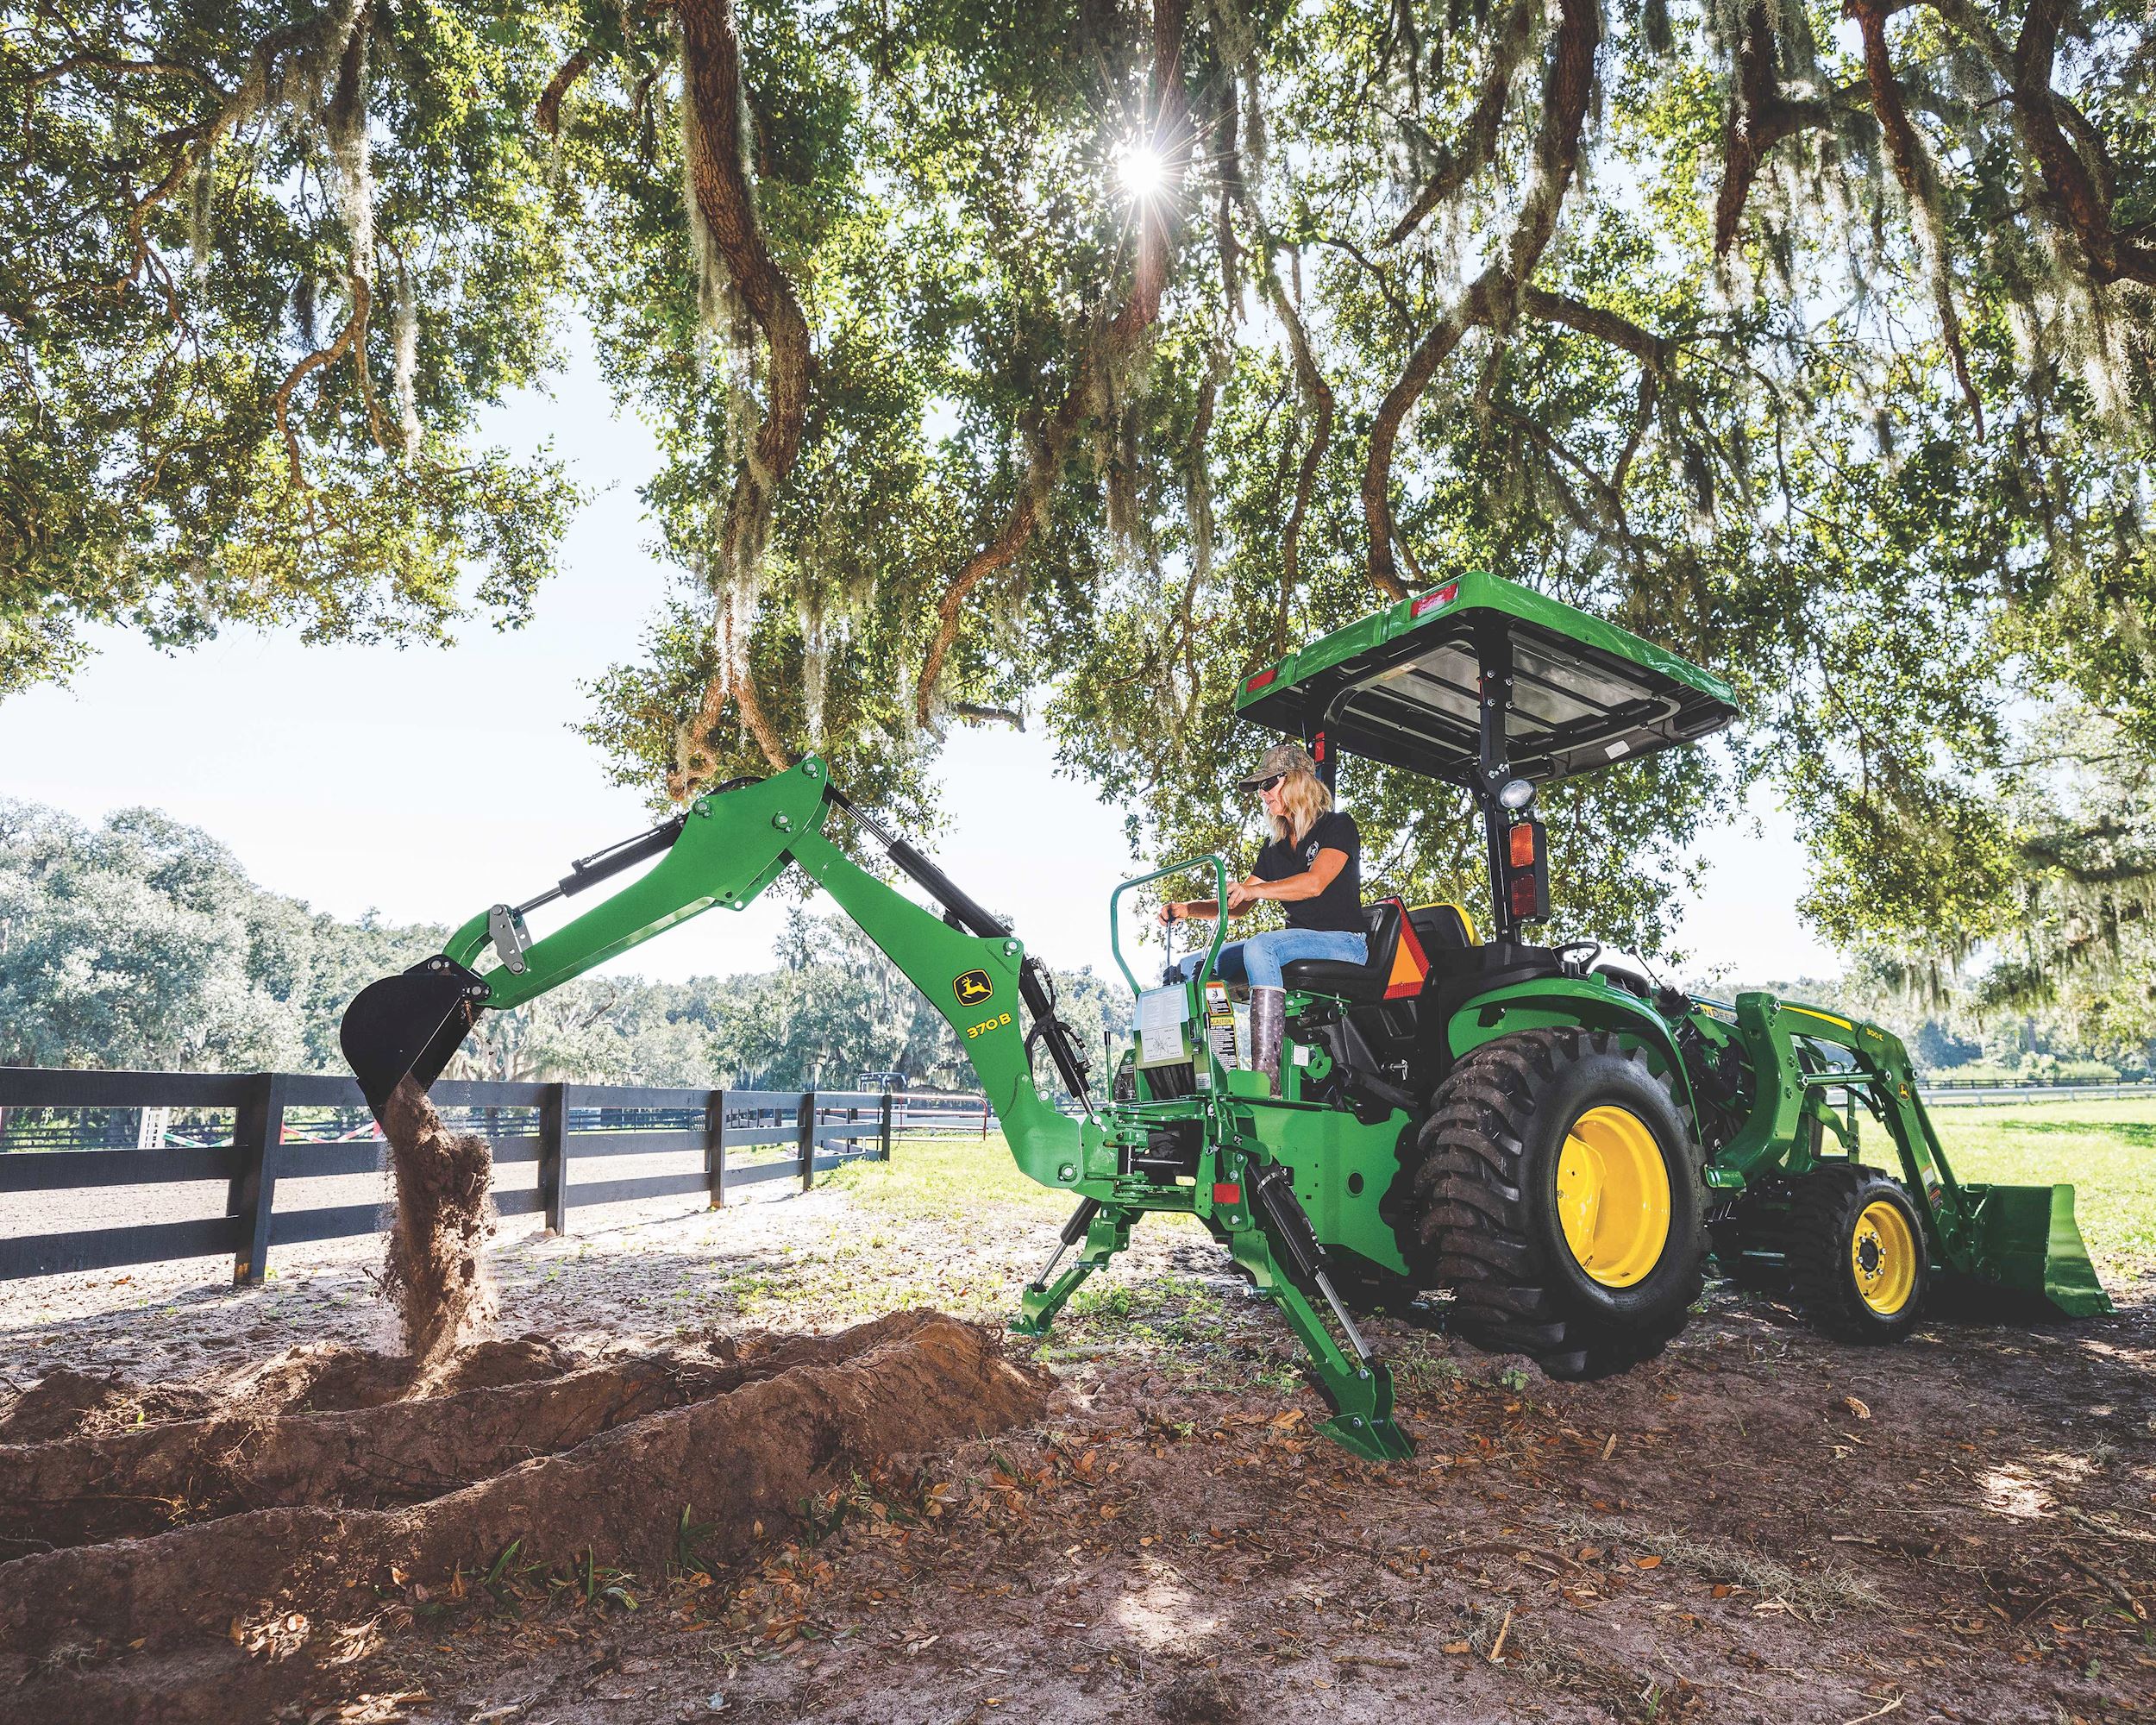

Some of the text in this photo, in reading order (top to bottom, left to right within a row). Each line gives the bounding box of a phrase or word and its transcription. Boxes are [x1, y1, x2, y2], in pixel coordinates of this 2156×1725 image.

[966, 1012, 1012, 1039] 370 B
[1712, 1009, 1736, 1023] DEER
